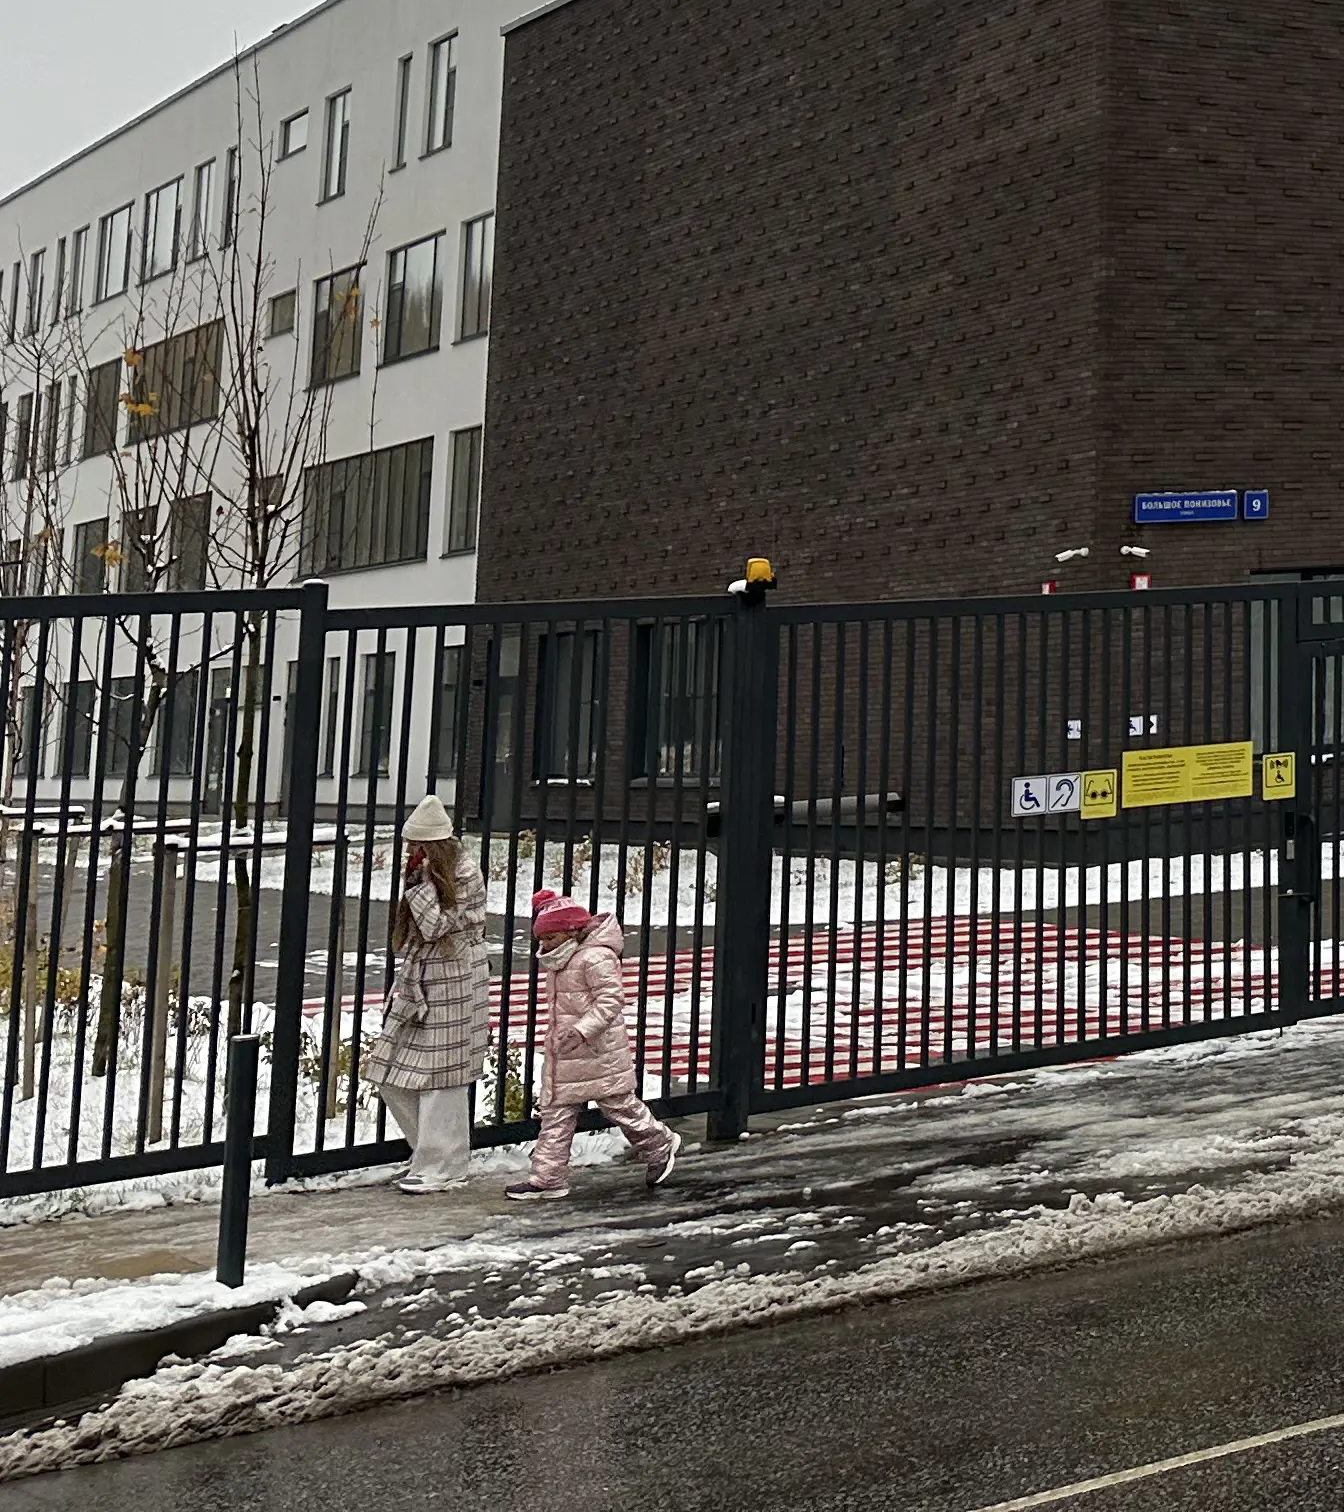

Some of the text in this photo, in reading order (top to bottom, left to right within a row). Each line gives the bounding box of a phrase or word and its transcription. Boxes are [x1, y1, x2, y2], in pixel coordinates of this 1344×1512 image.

[1142, 498, 1232, 510] БОЛЬШОЕ ПОНИЗОВЬЕ
[1252, 499, 1261, 511] 9
